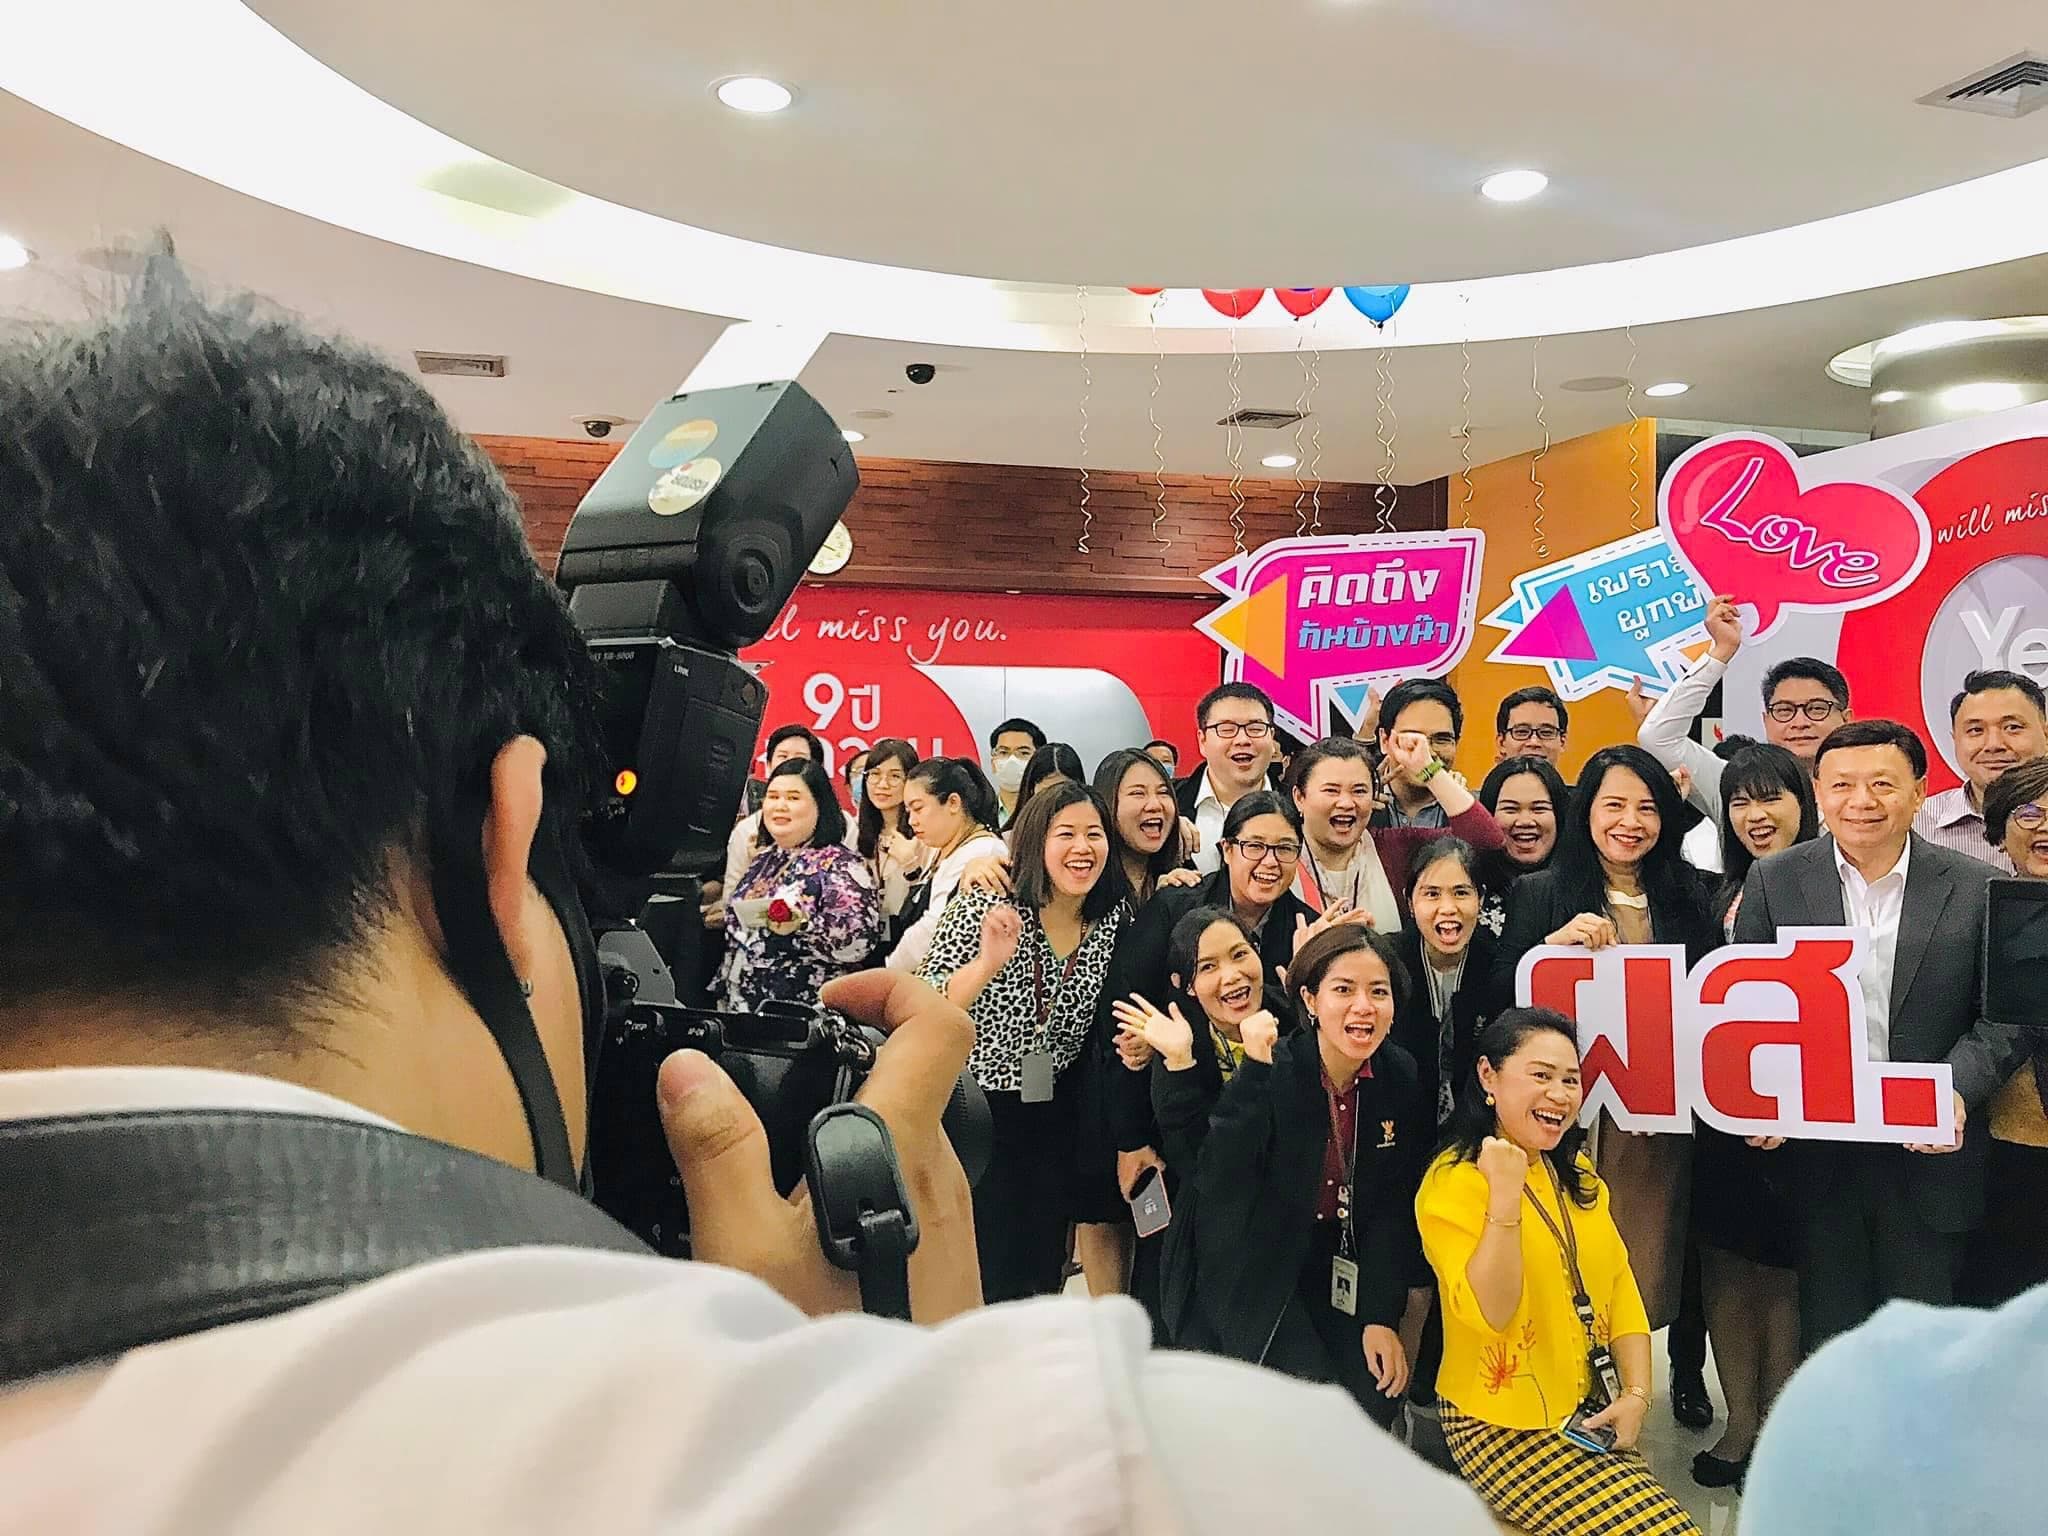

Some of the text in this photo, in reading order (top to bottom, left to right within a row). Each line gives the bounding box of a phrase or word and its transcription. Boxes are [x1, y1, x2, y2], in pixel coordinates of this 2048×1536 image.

[1700, 457, 1880, 588] Love
[1937, 503, 1994, 544] will
[1297, 557, 1441, 609] คิดถึง
[817, 609, 908, 643] miss
[906, 616, 1009, 665] you.
[1530, 939, 1938, 1128] ผส.
